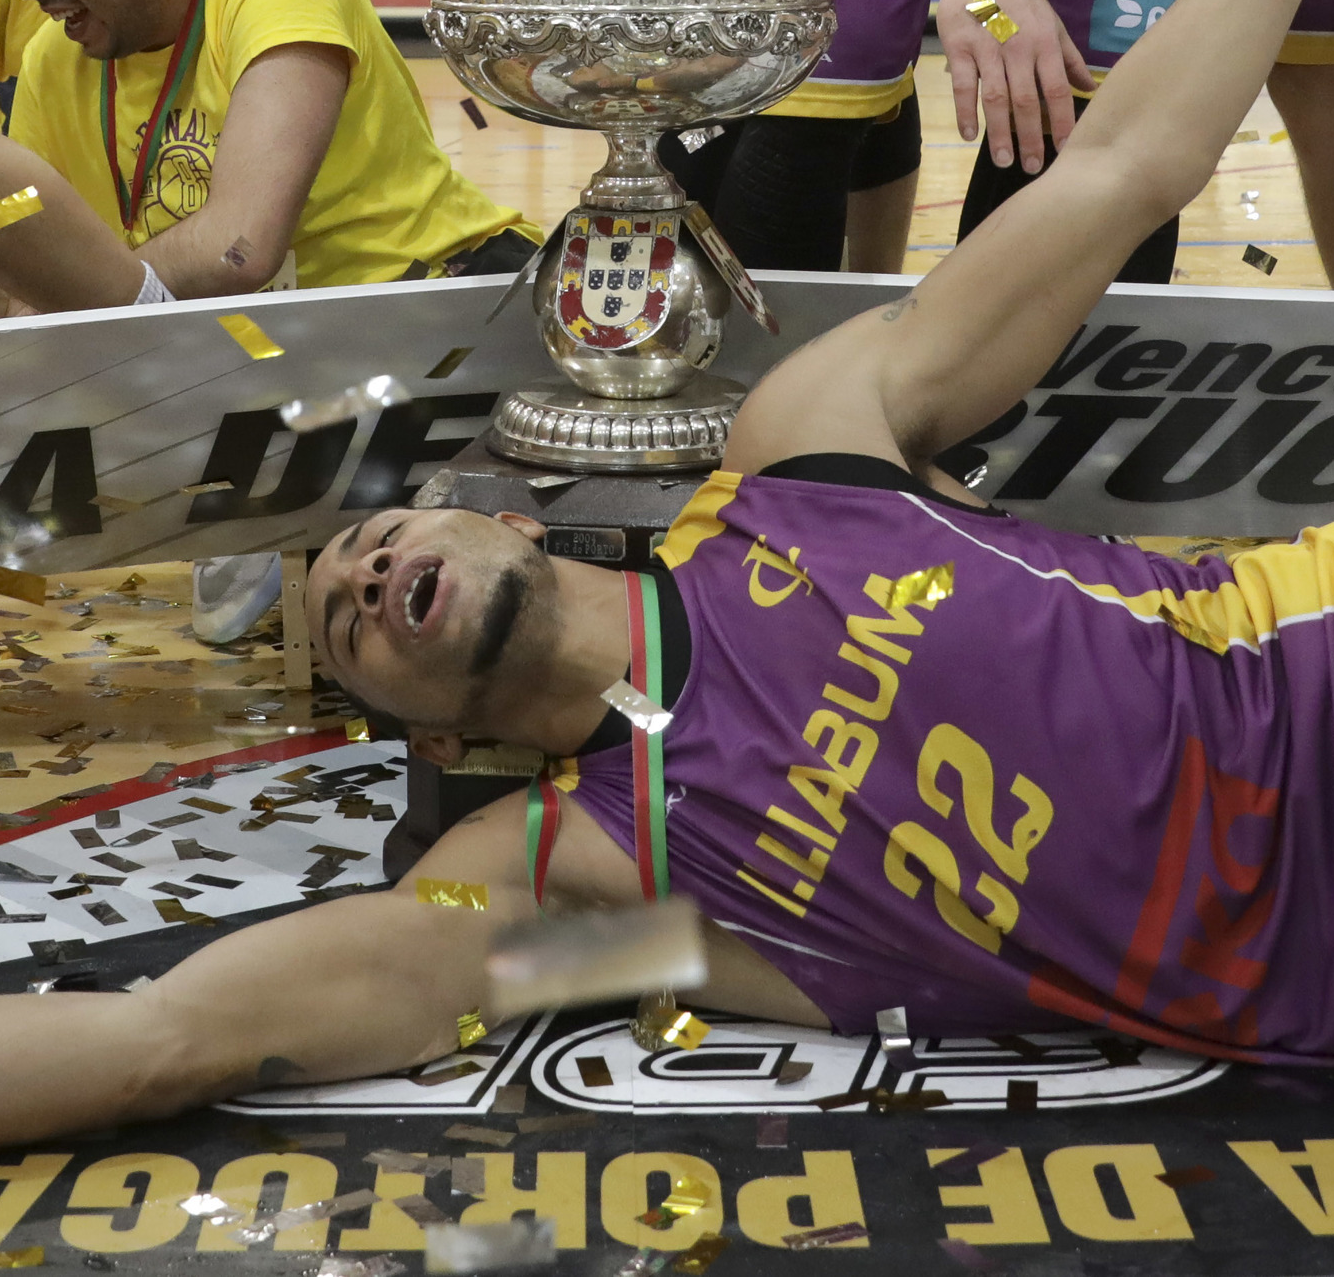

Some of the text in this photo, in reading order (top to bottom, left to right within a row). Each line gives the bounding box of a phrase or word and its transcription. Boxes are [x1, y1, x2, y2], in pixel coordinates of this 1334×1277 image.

[186, 391, 500, 524] DE
[883, 723, 1054, 955] 22
[925, 1142, 1196, 1244] DE
